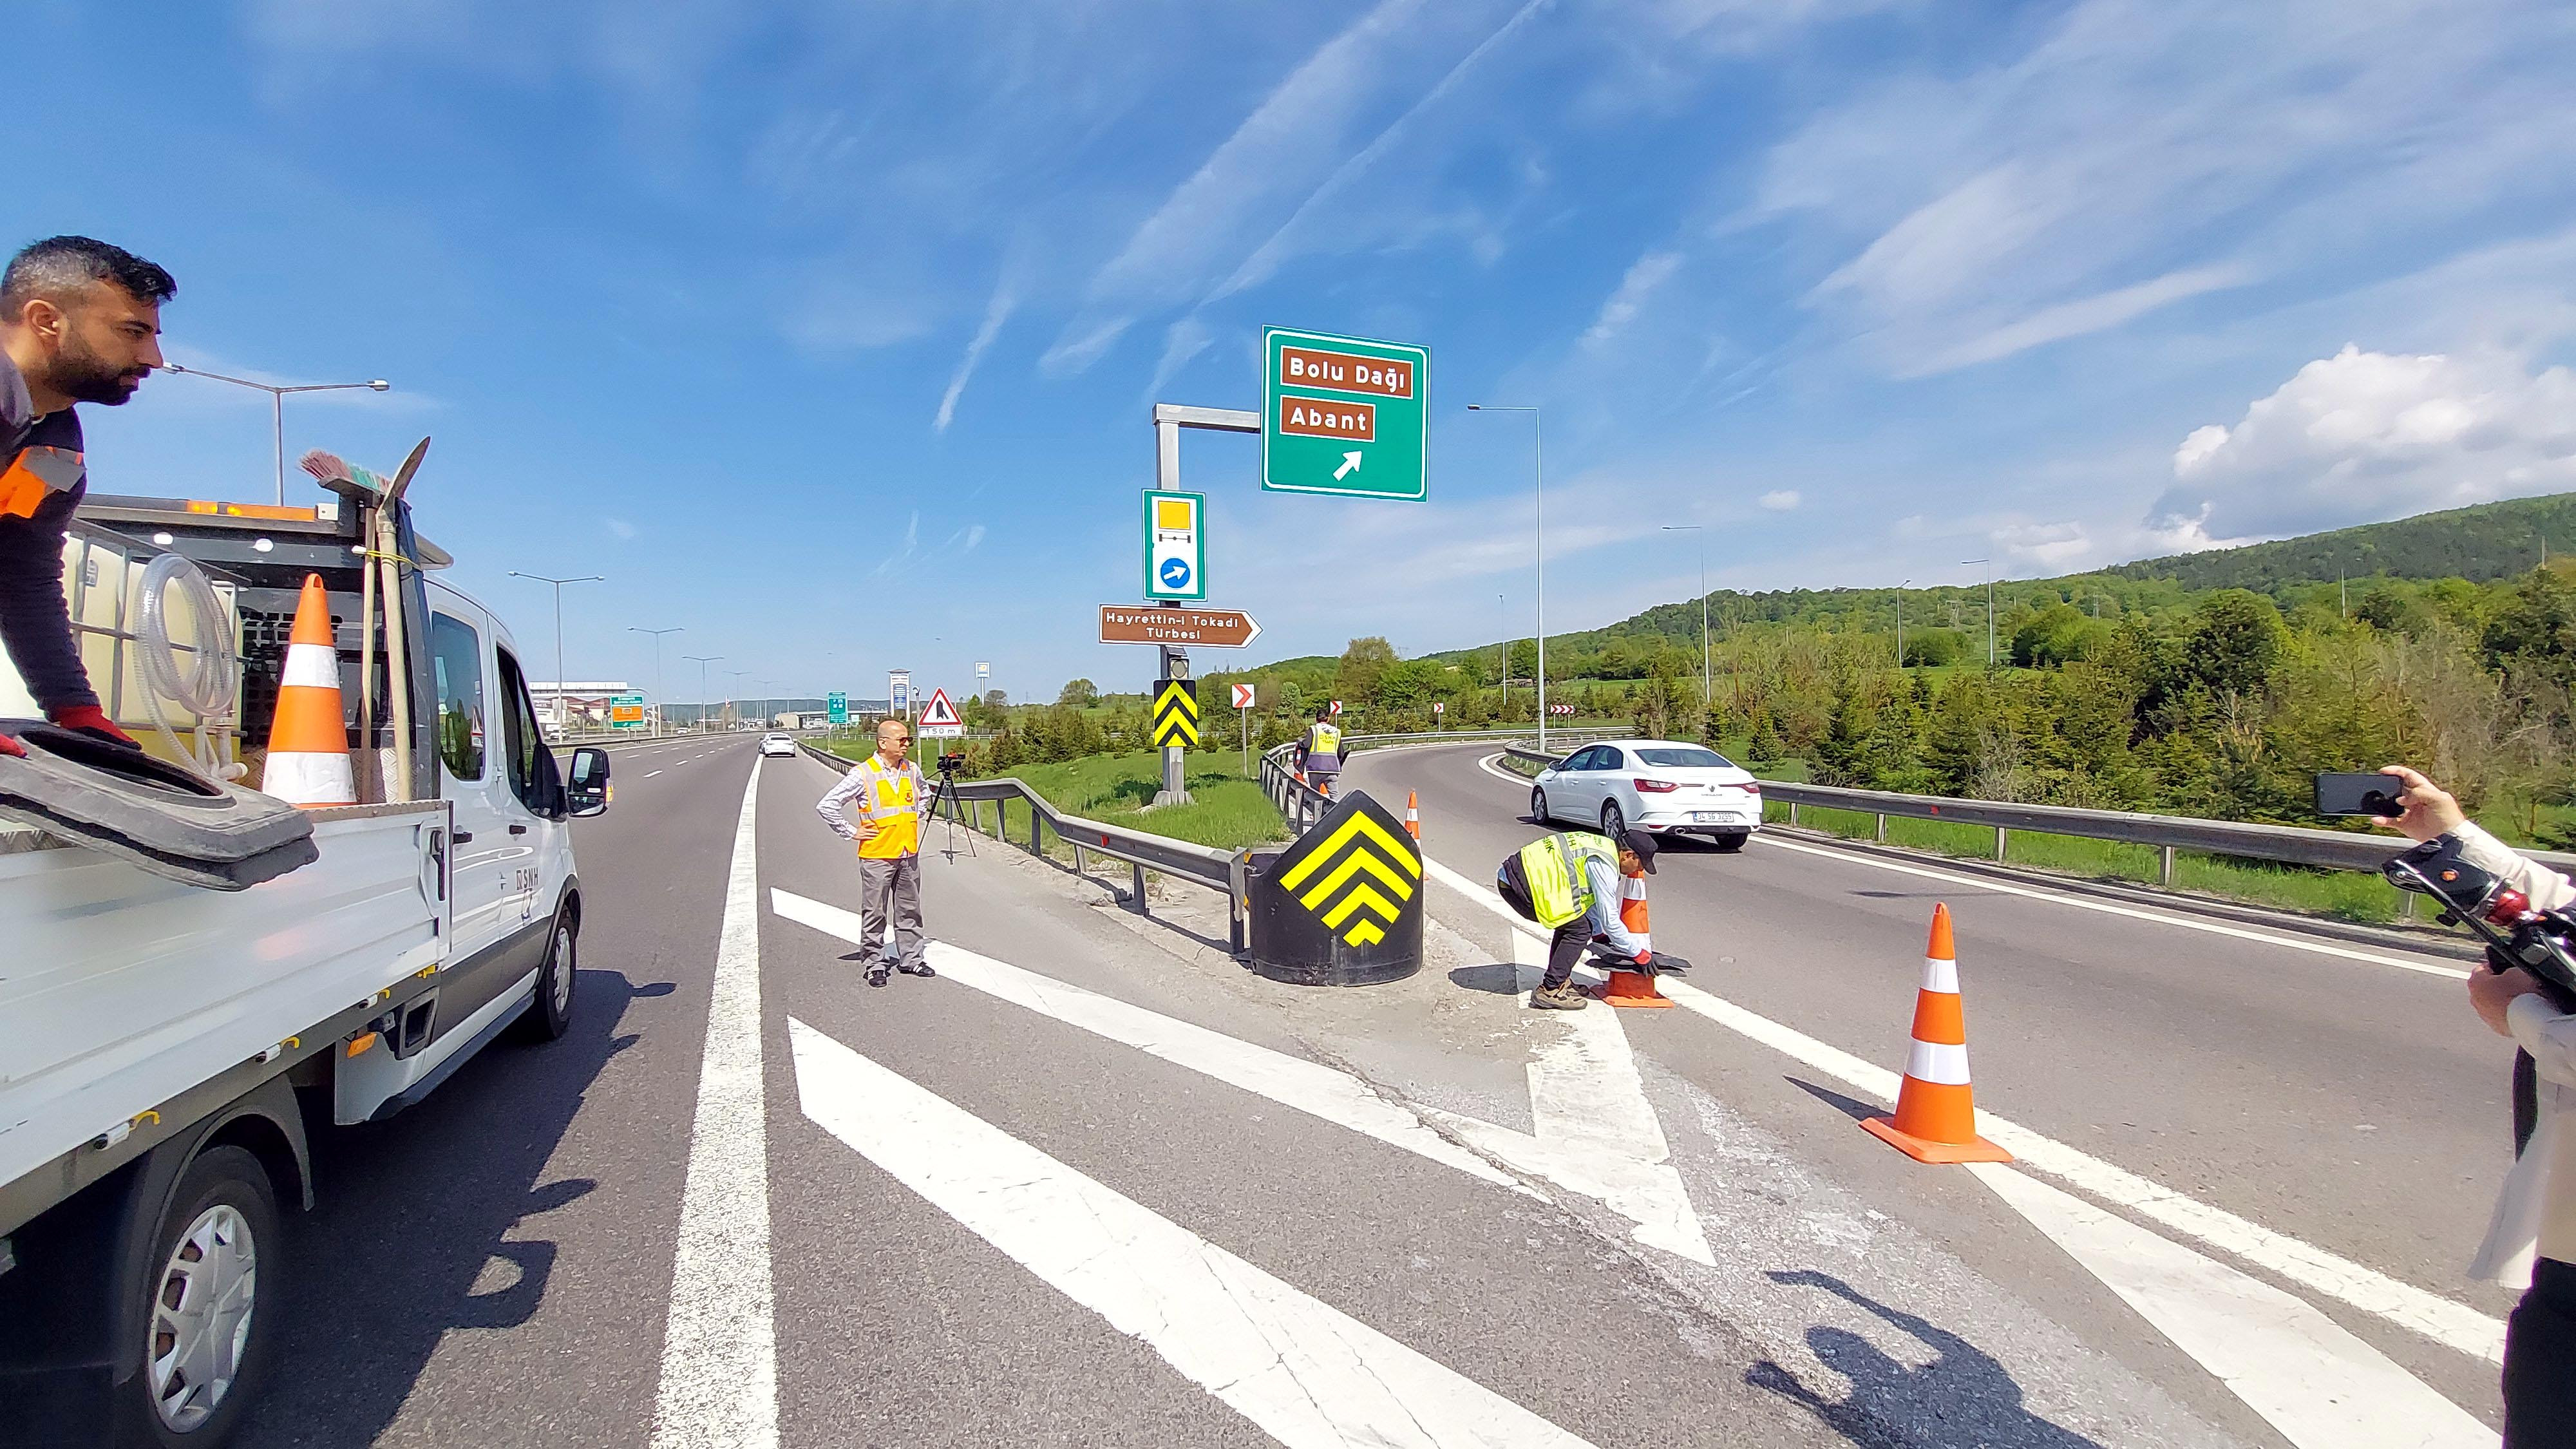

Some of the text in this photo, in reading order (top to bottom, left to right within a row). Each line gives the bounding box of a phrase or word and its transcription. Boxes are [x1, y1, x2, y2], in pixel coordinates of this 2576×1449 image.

[1290, 357, 1405, 393] Bolu Dağı
[1290, 406, 1366, 431] Abant
[1106, 612, 1238, 628] Hayrettin-i Tokadi
[1146, 627, 1200, 639] Türbesi
